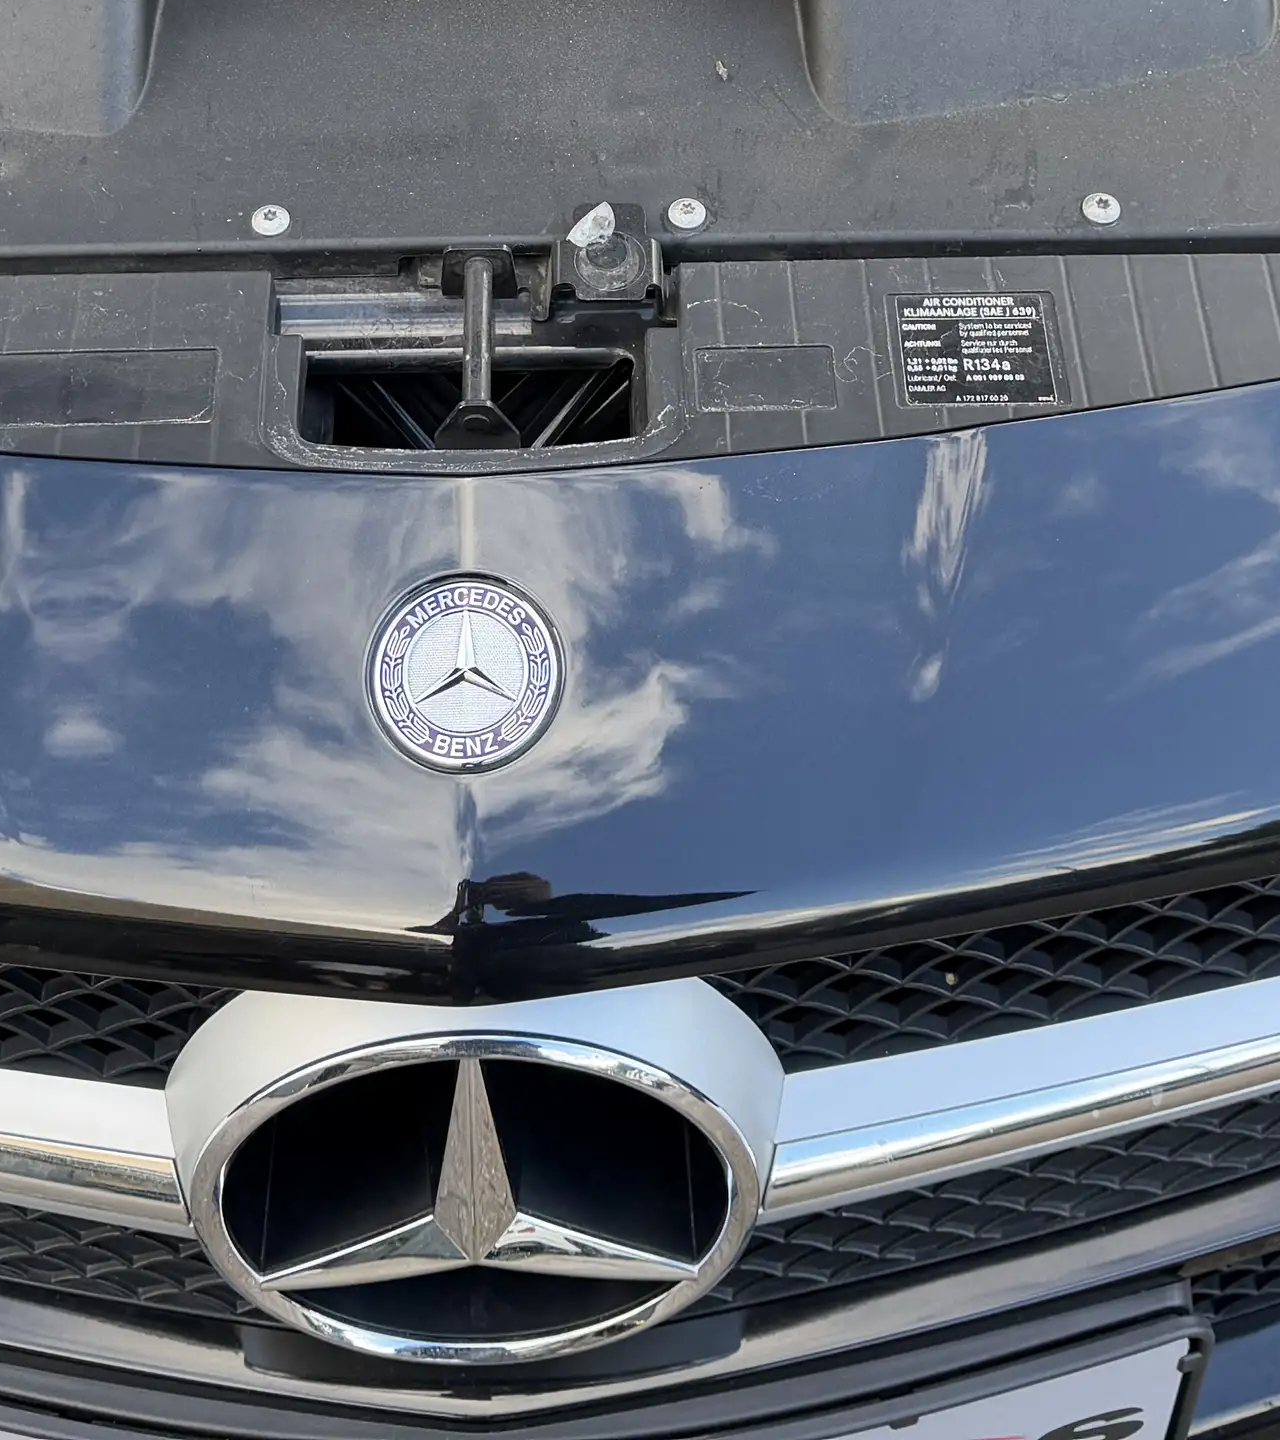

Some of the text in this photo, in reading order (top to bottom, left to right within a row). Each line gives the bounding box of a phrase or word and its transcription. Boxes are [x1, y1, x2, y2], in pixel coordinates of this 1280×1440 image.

[922, 296, 1015, 307] AIR CONDITIONER
[903, 306, 1036, 319] KLIMAANLAGE (SAE J 639)
[958, 322, 985, 331] System
[985, 322, 993, 330] to
[959, 329, 1030, 338] by qualified personnel
[960, 339, 1019, 347] Service nur durch
[962, 357, 1011, 371] R134a
[963, 394, 975, 402] 172
[975, 394, 989, 402] 817
[405, 587, 526, 629] MERCEDES
[432, 732, 499, 757] BENZ
